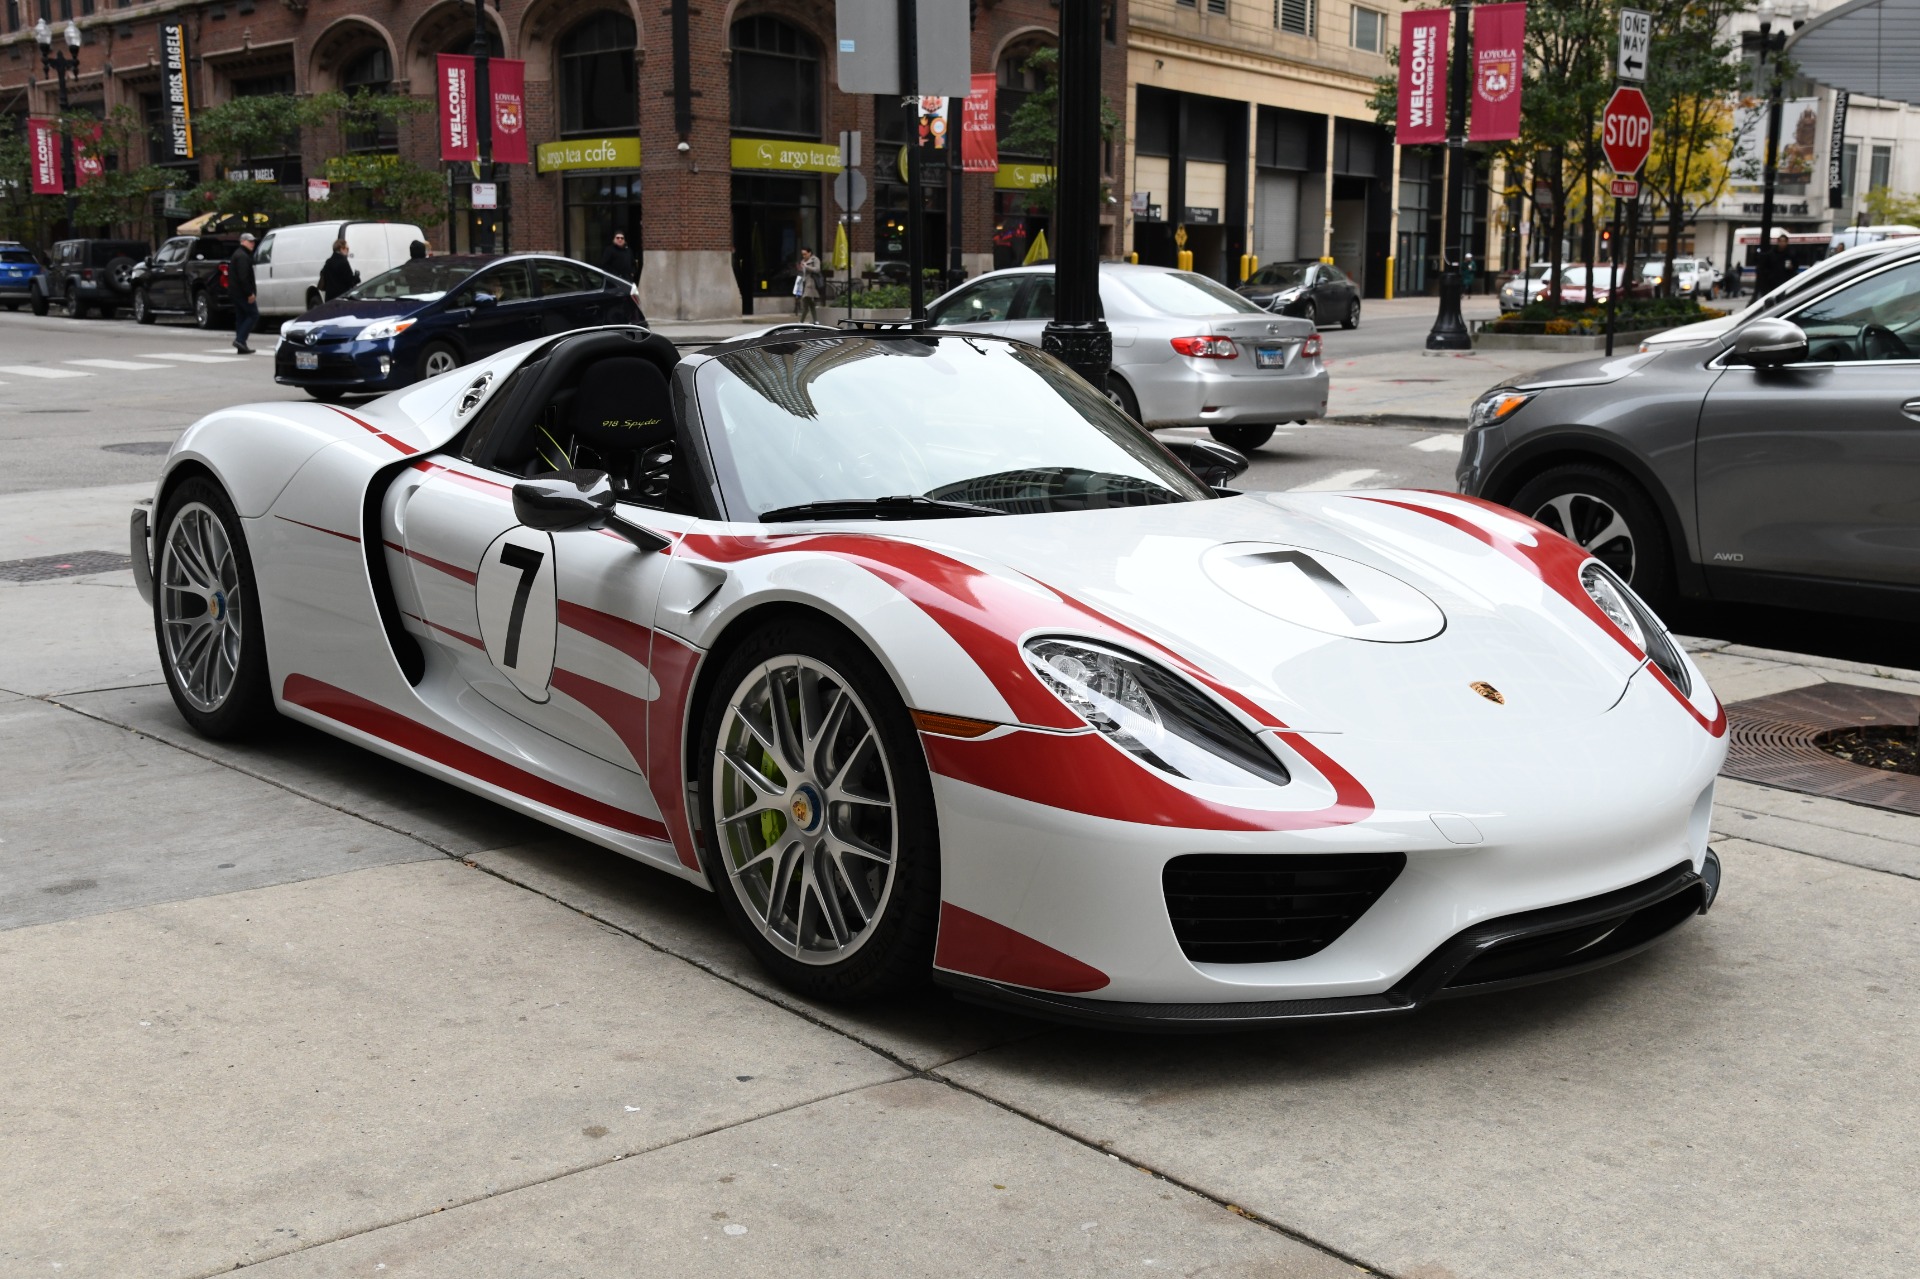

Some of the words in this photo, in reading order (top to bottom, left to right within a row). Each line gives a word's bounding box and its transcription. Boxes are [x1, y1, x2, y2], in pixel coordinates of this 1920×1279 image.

[1624, 15, 1647, 34] ONE
[165, 26, 183, 70] BAGELS
[1427, 26, 1437, 64] CAMPUS
[1479, 49, 1516, 59] LOYOLA
[1623, 34, 1646, 53] WAY
[1410, 26, 1428, 128] WELCOME
[1426, 65, 1435, 96] TOWER
[448, 67, 462, 148] WELCOME
[460, 99, 468, 123] TOWER
[495, 93, 520, 101] LOYOLA
[964, 99, 989, 111] David
[974, 111, 989, 121] Lee
[1425, 97, 1433, 127] WATER
[1830, 91, 1846, 161] NORDSTROM
[172, 105, 188, 156] EINSTEIN
[1606, 113, 1649, 147] STOP
[36, 128, 50, 185] WELCOME
[547, 151, 564, 169] argo
[566, 148, 581, 163] tea
[585, 139, 616, 162] café
[780, 150, 808, 169] argo
[810, 150, 824, 166] tea
[254, 168, 275, 181] BAGELS
[1612, 182, 1623, 194] ALL
[1623, 183, 1636, 194] WAY
[1830, 163, 1842, 189] rack
[622, 418, 661, 430] Spyder
[1713, 552, 1744, 562] AWD
[1224, 549, 1381, 627] 7
[500, 542, 544, 669] 7
